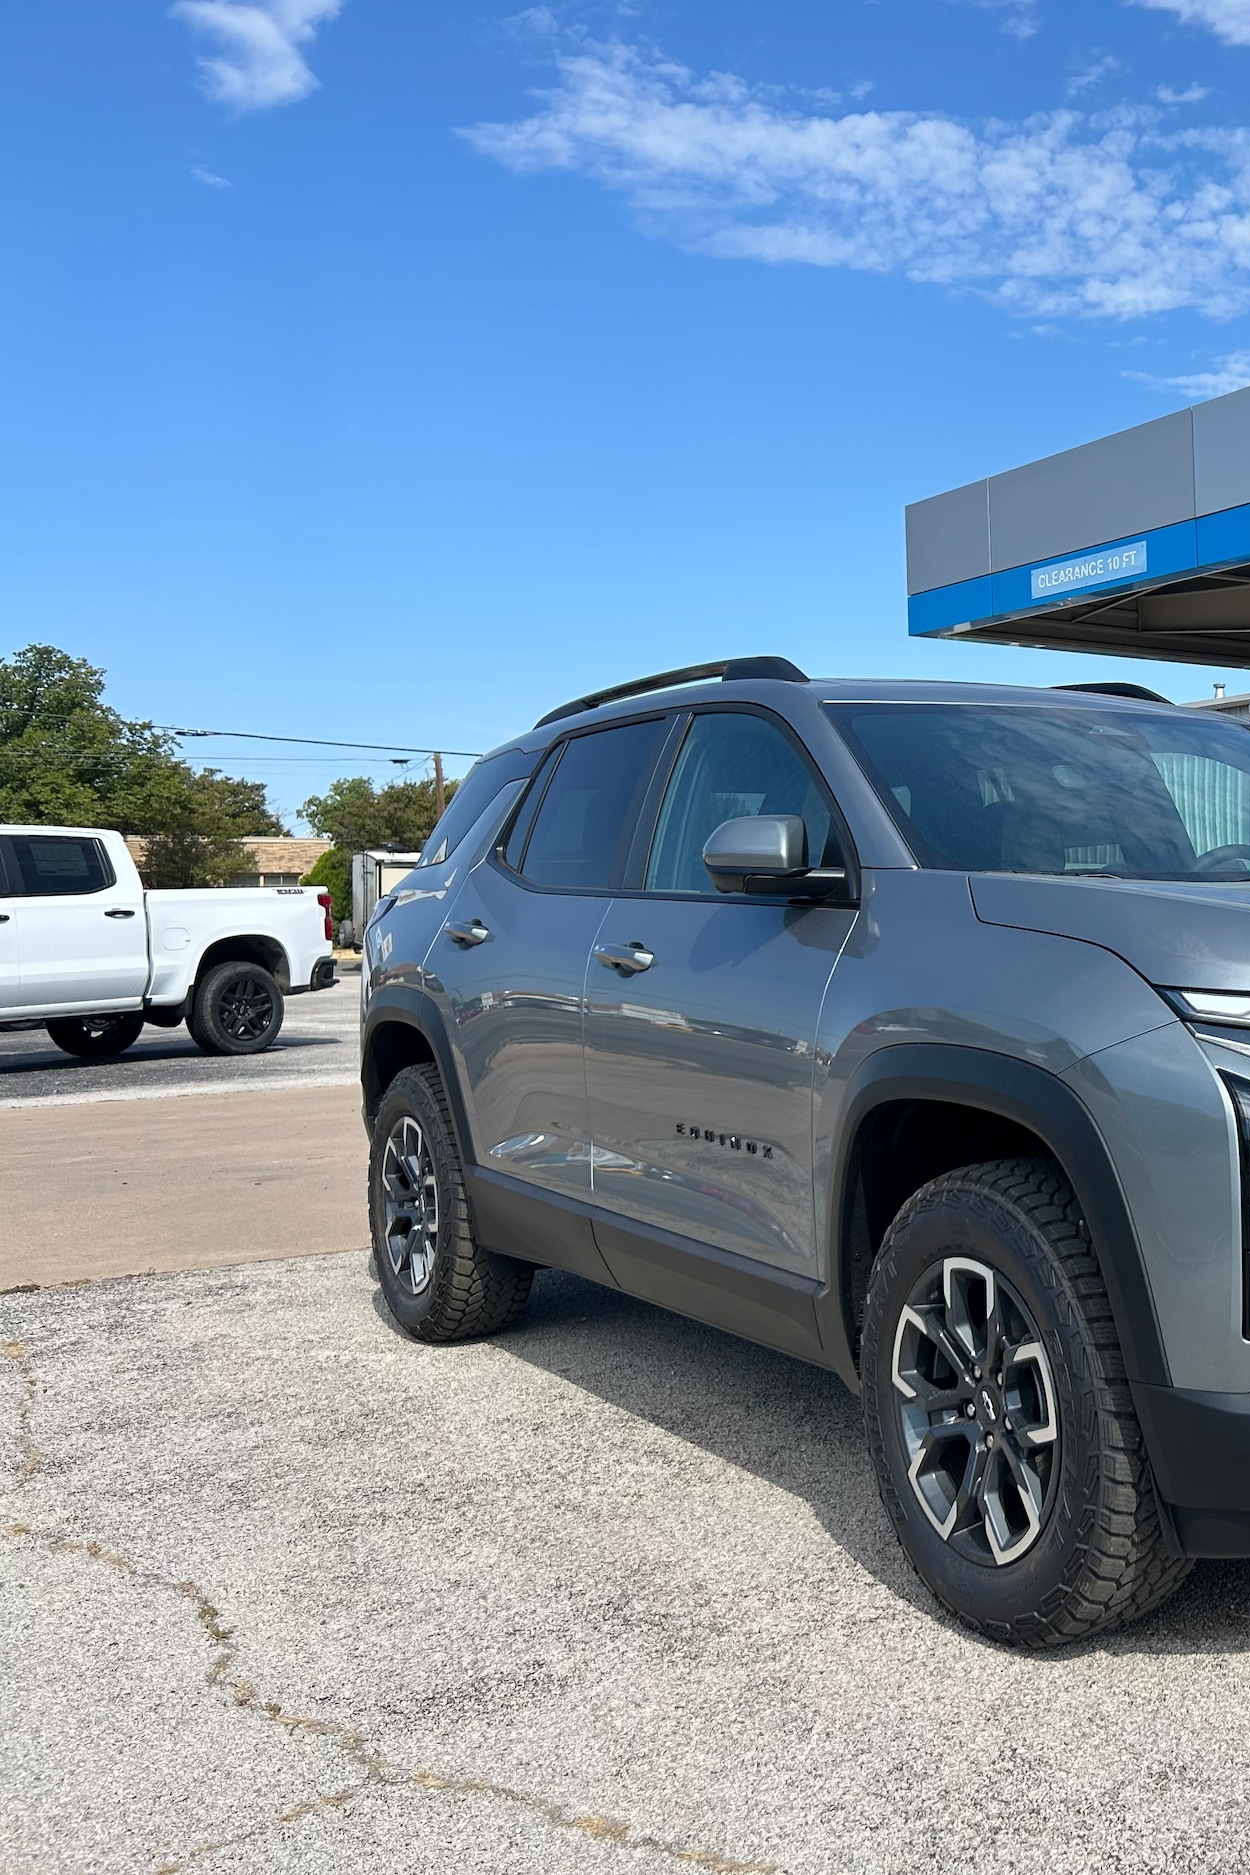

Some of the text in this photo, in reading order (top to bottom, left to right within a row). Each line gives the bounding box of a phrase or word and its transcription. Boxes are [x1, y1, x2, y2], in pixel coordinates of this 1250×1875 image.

[1038, 551, 1137, 588] CLEARANCE 10 FT
[862, 1322, 908, 1522] GRABBER
